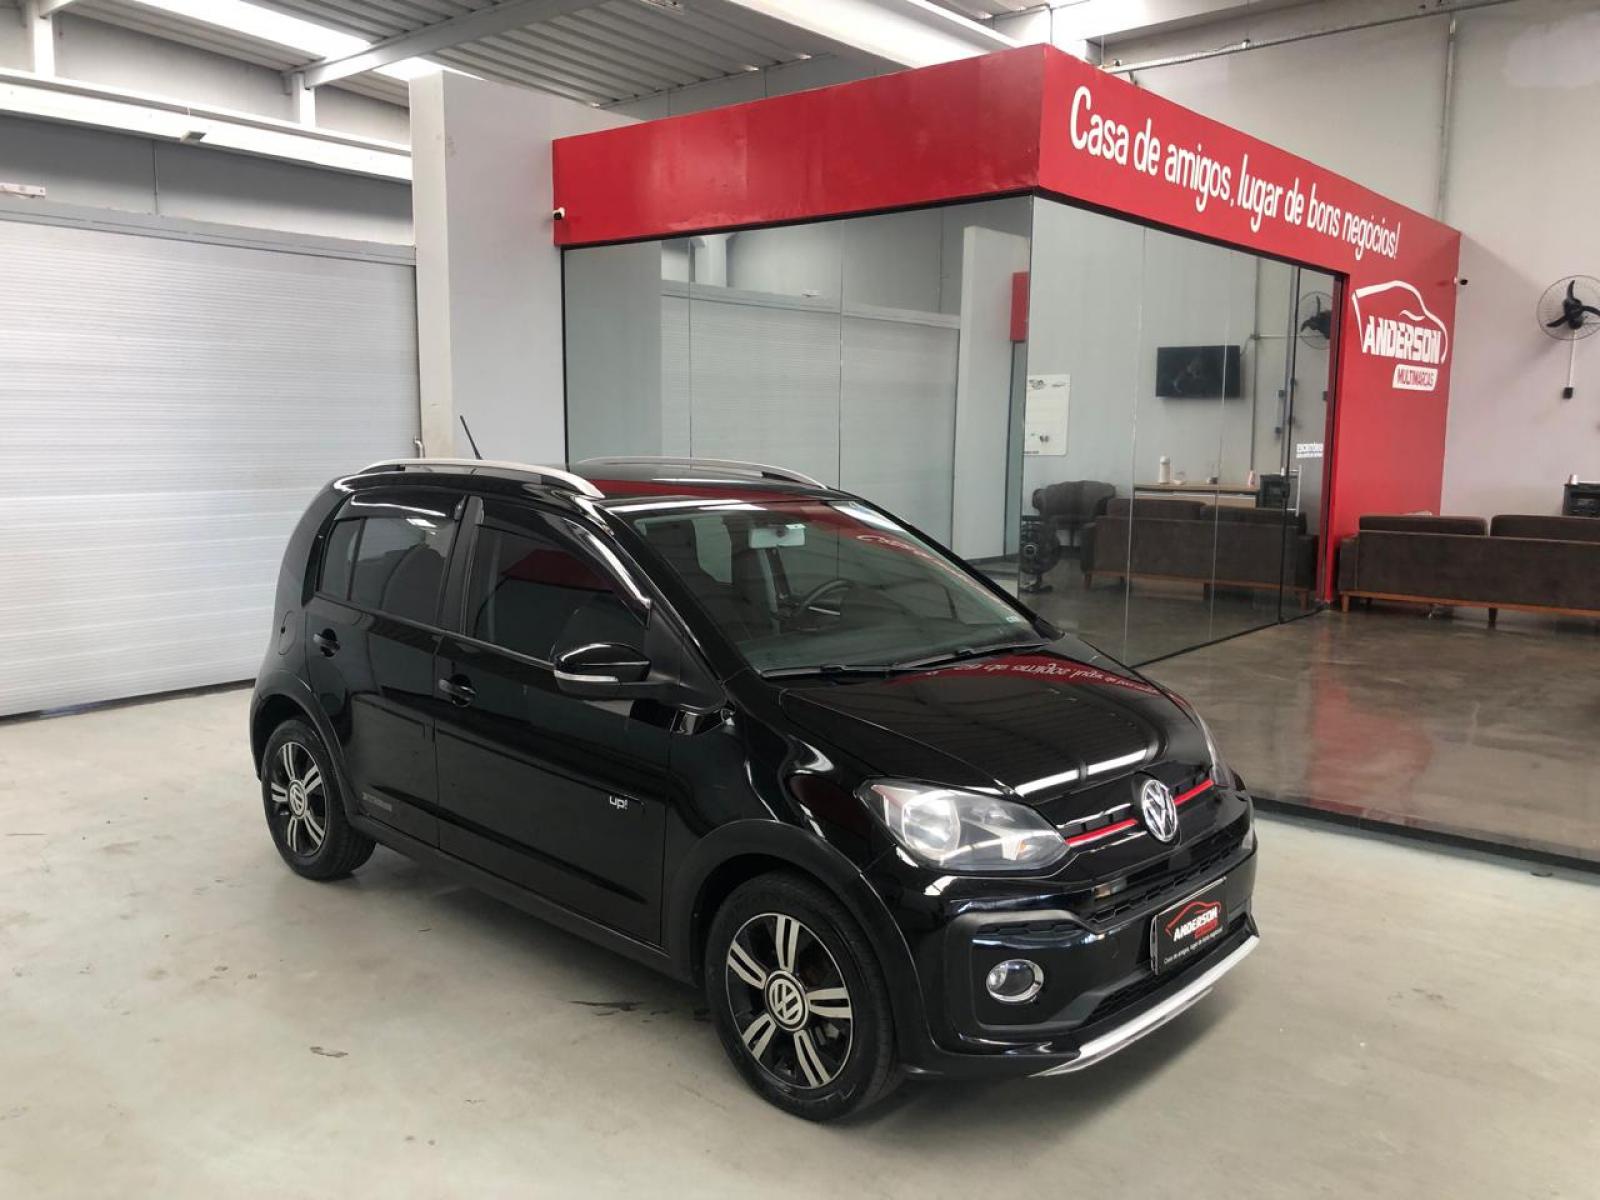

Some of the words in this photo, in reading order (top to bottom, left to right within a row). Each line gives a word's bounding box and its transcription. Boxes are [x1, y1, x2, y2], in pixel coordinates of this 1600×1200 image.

[1070, 86, 1129, 165] Casa
[1133, 118, 1160, 176] de
[1164, 143, 1235, 212] amigos,
[1237, 154, 1283, 232] lugar
[1284, 178, 1304, 225] de
[1307, 183, 1340, 239] bons
[1342, 214, 1401, 260] negócios!
[1362, 315, 1441, 364] ANDERSON
[609, 795, 628, 810] up!
[1173, 906, 1218, 942] ANDERSON
